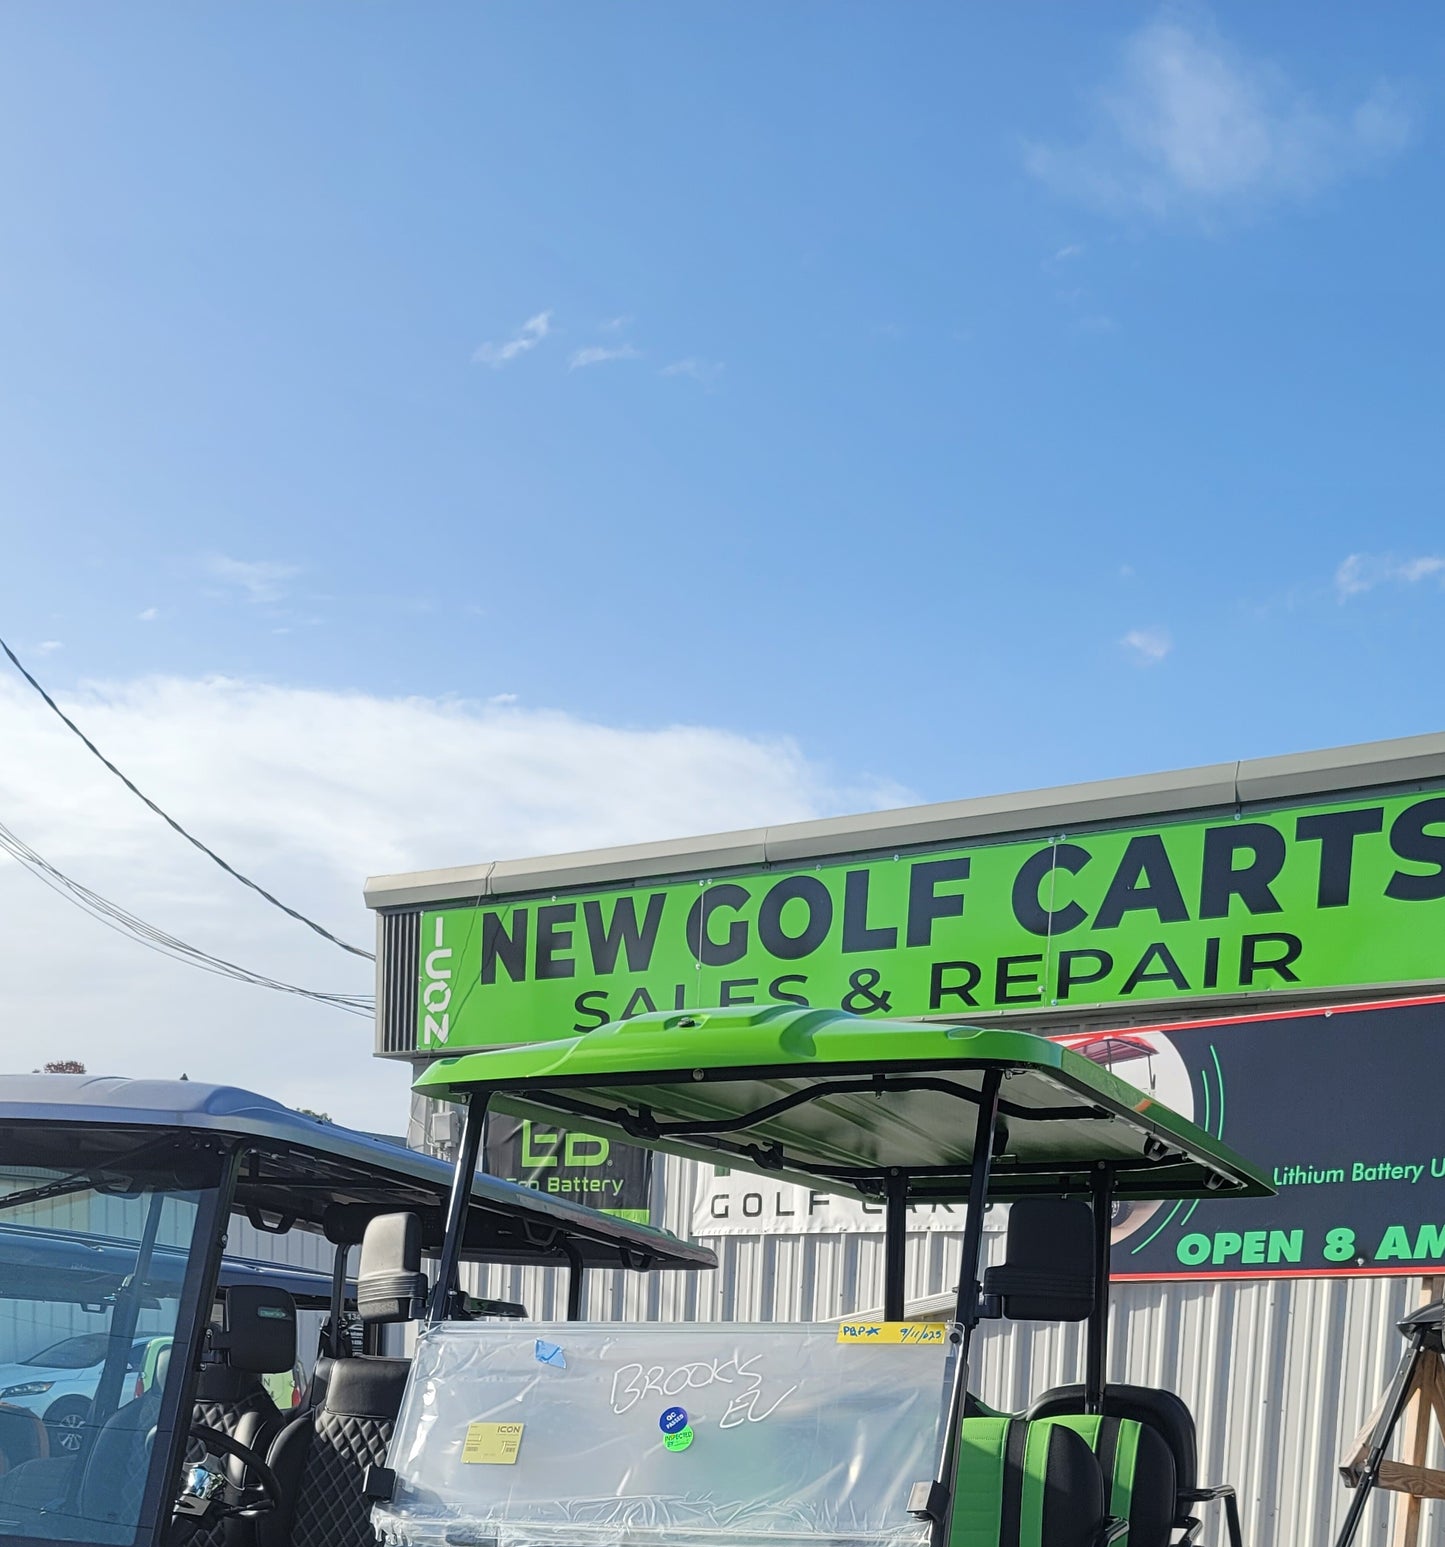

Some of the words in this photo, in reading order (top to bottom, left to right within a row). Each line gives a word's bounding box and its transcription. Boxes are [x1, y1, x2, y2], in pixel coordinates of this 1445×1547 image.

[480, 893, 667, 985] NEW
[686, 857, 971, 967] GOLF
[1011, 797, 1445, 937] CARTS
[423, 916, 452, 1045] ICON
[841, 968, 893, 1015] &
[929, 932, 1302, 1009] REPAIR
[547, 1177, 624, 1196] Battery
[1274, 1165, 1344, 1186] Lithium
[1352, 1162, 1424, 1184] Battery
[710, 1190, 829, 1218] GOLF
[1176, 1229, 1304, 1266] OPEN
[1323, 1227, 1356, 1262] 8
[1374, 1224, 1445, 1260] AM
[665, 1413, 684, 1429] PASSED
[666, 1411, 676, 1421] QC
